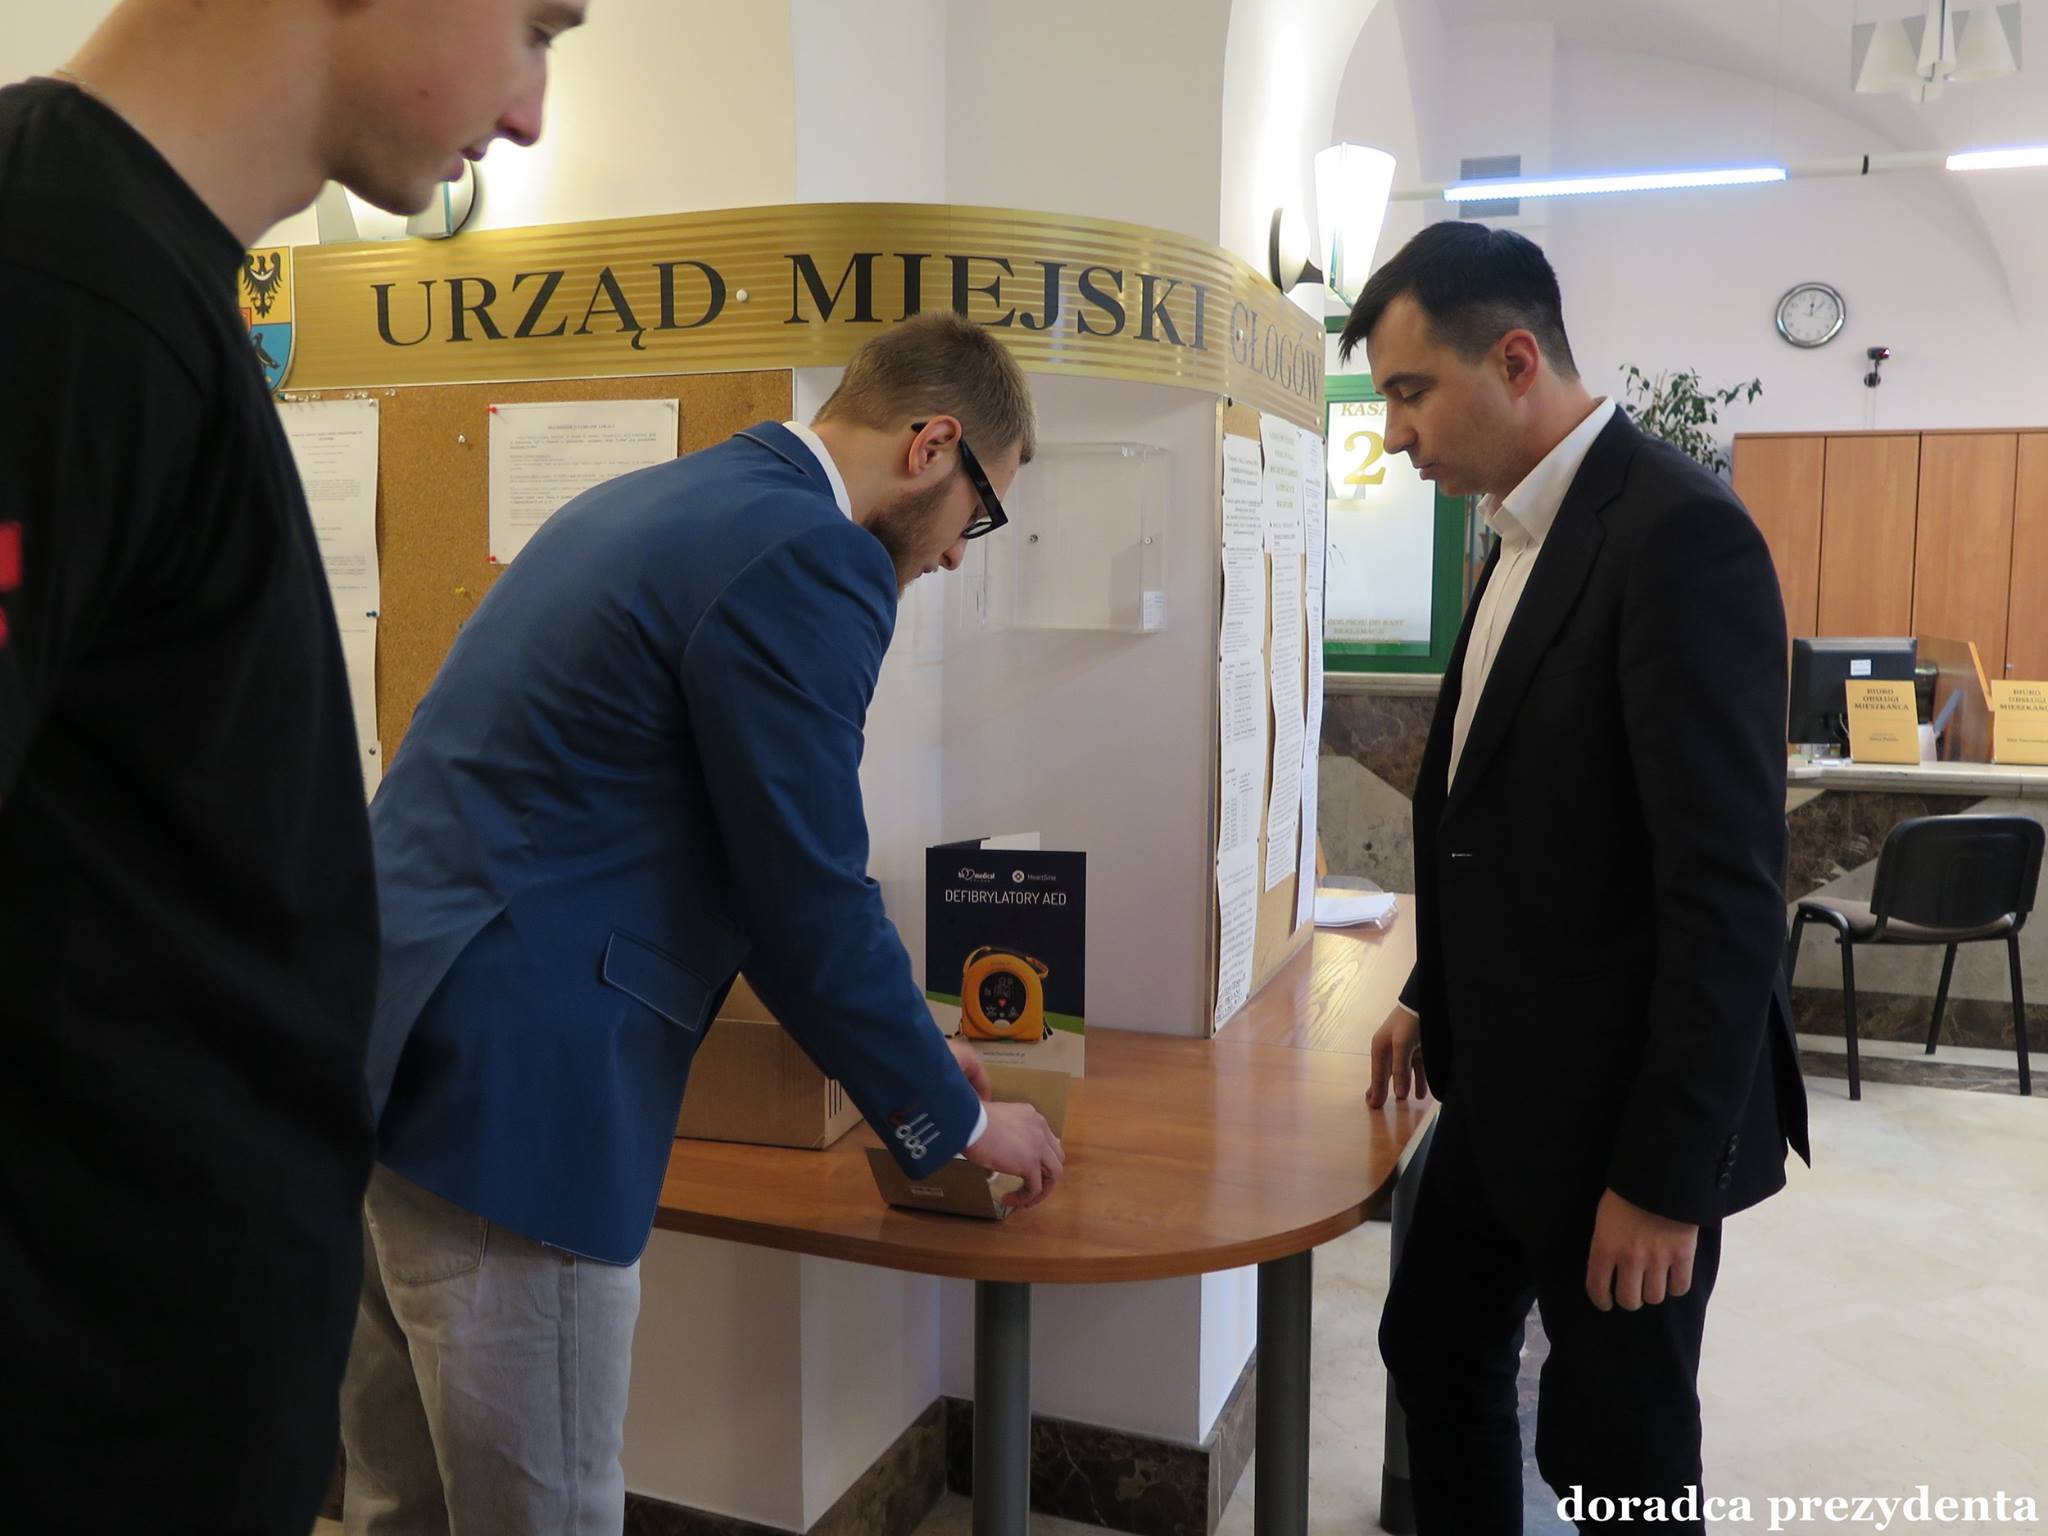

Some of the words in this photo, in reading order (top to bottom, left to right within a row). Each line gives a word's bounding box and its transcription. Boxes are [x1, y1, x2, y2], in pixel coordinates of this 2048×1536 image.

[370, 260, 727, 350] URZĄD
[783, 252, 1208, 351] MIEJSKI
[1230, 302, 1322, 404] GŁOGÓW
[1343, 430, 1387, 485] 2
[944, 889, 1040, 905] DEFIBRYLATORY
[1042, 892, 1068, 906] AED
